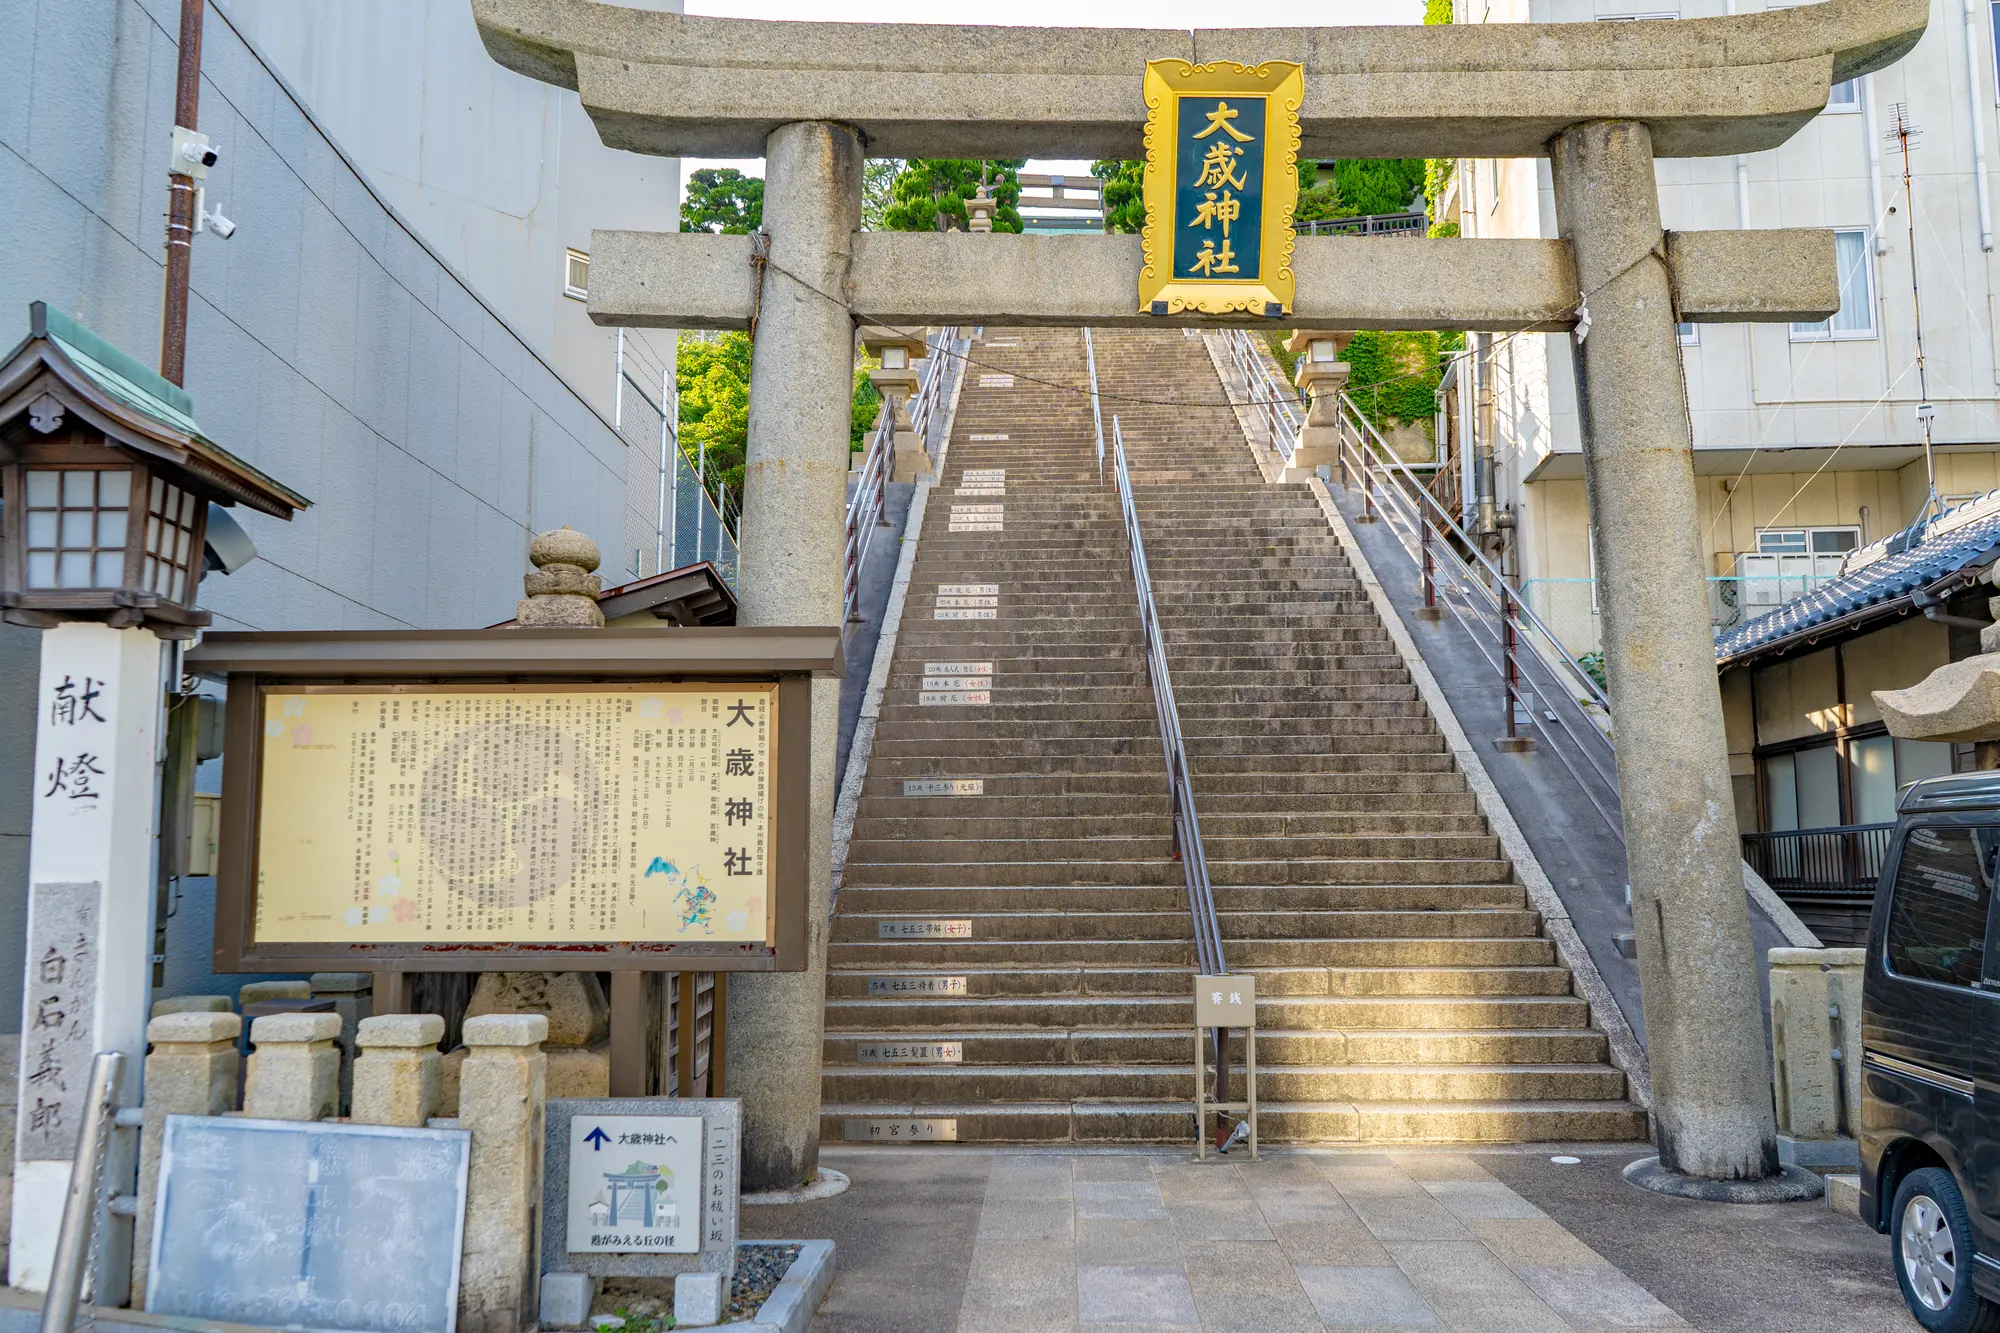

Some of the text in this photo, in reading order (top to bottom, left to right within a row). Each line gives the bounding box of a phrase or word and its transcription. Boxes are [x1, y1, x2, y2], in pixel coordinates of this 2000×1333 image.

[1188, 101, 1255, 277] 大歳神社
[625, 699, 632, 713] 由緒
[724, 699, 755, 877] 大歳神社
[27, 946, 68, 1141] 白石義郎
[618, 1132, 679, 1147] 大歳神社へ
[710, 1126, 726, 1243] 一二三のお祓い坂
[591, 1233, 676, 1248] 港がみえる丘の径
